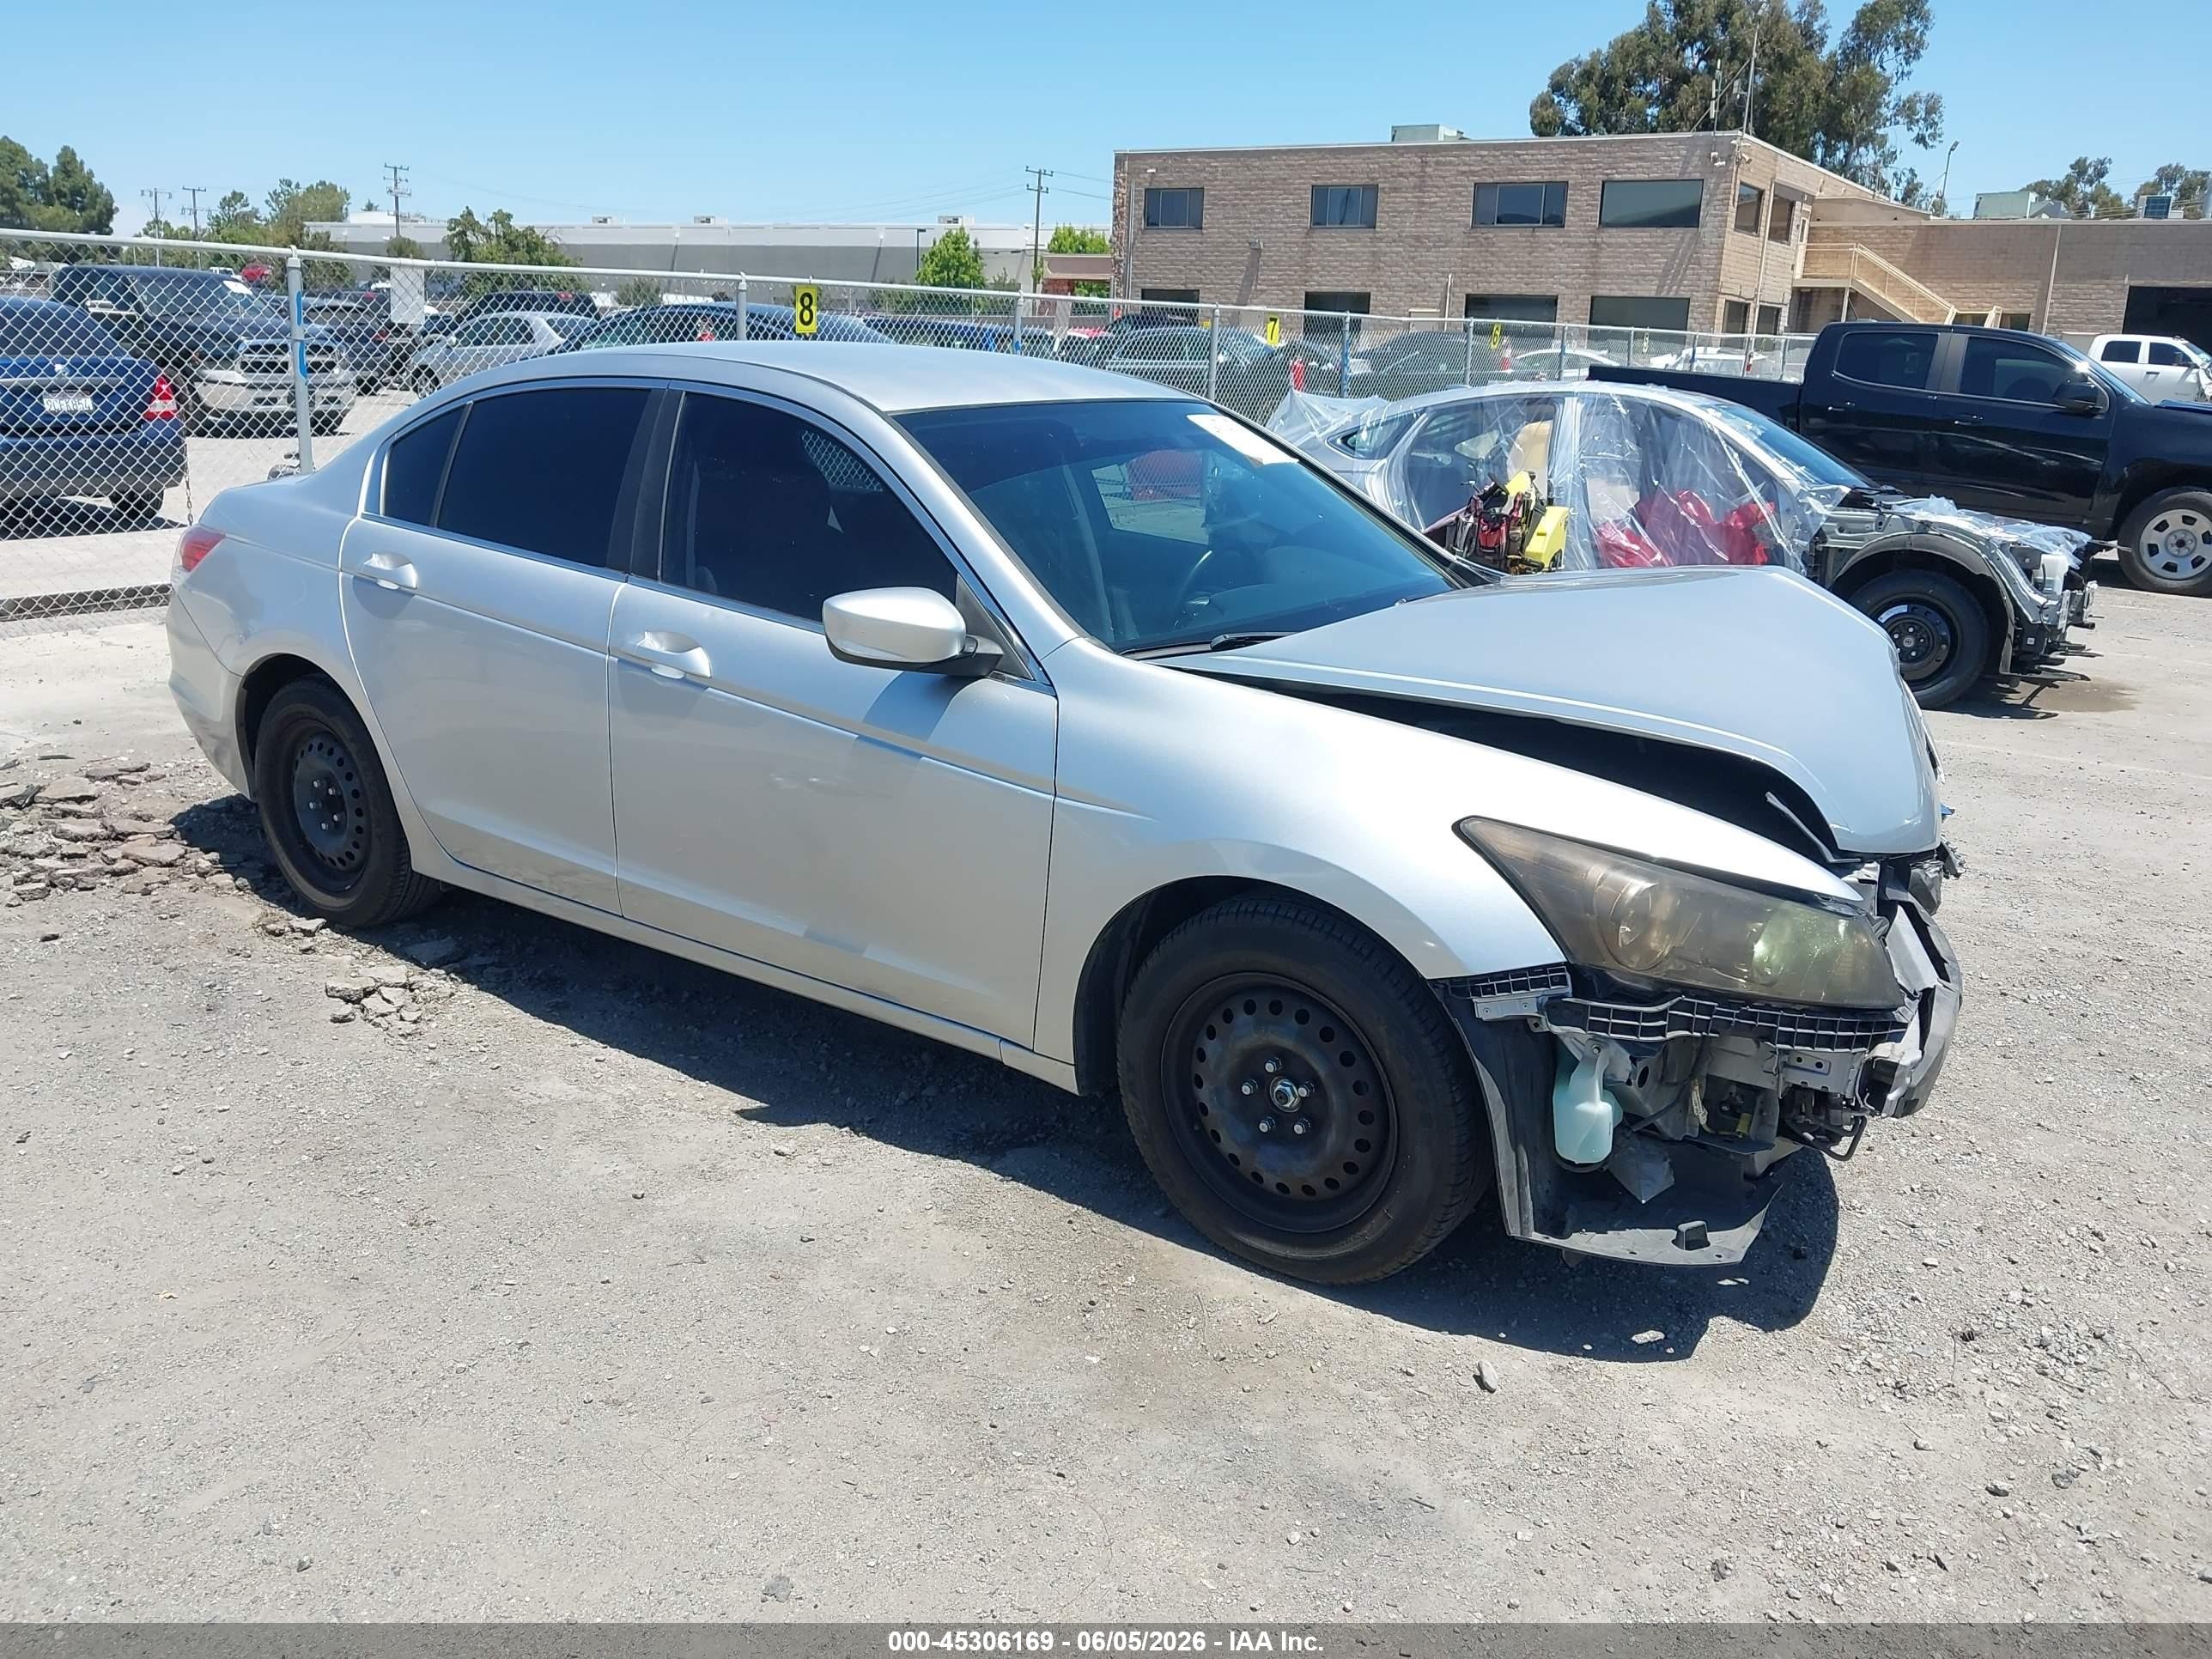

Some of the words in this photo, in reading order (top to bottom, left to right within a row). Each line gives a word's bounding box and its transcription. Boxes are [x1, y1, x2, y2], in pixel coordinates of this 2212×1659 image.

[799, 292, 814, 326] 8
[1269, 317, 1278, 341] 7
[1492, 326, 1499, 345] 6
